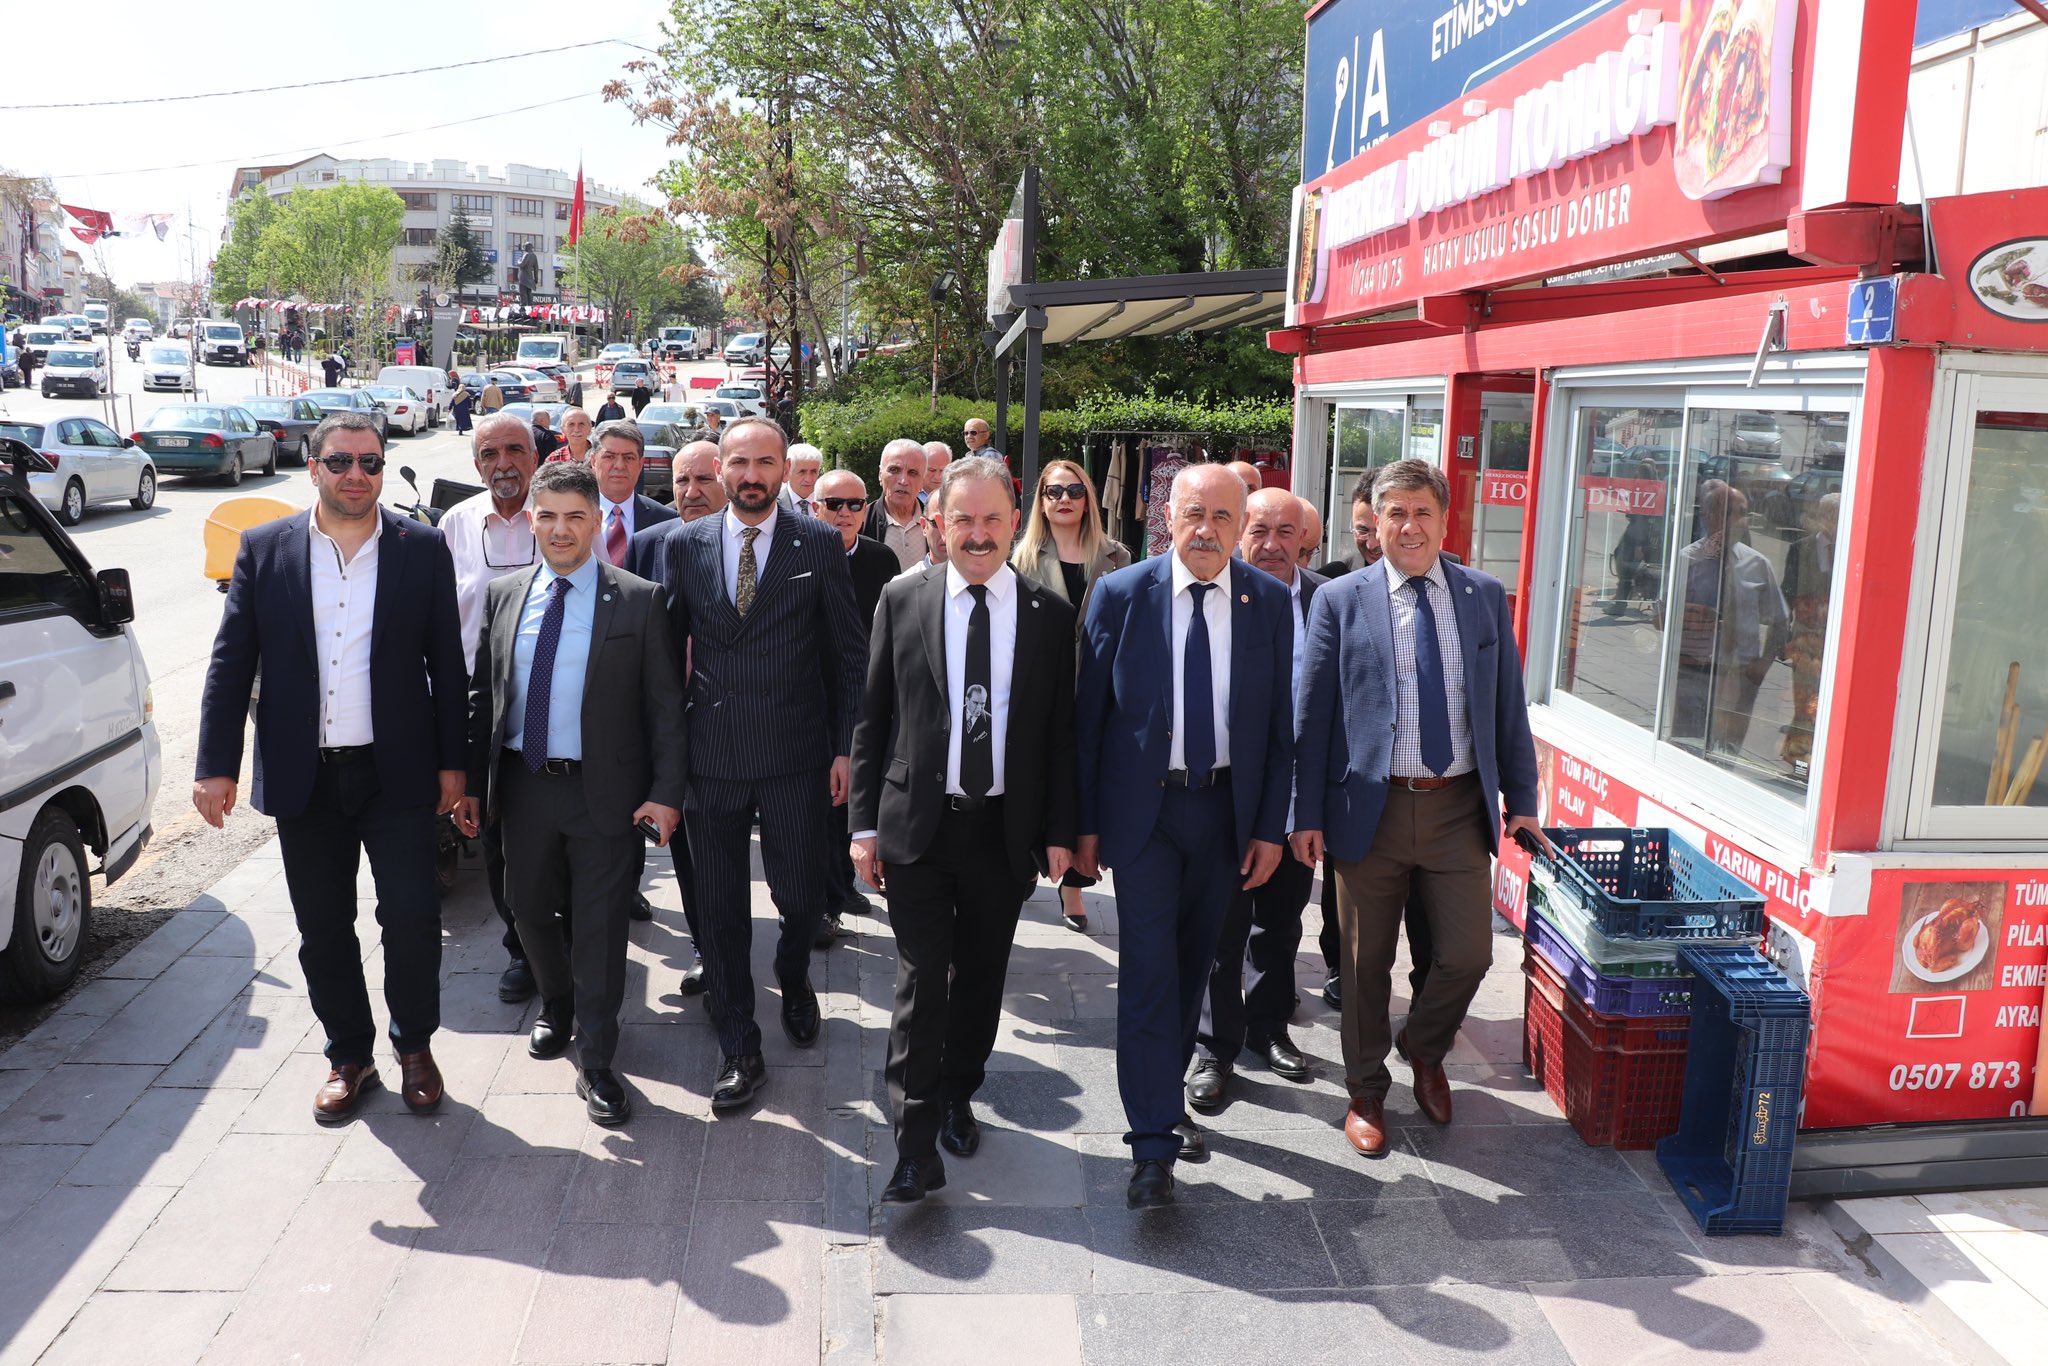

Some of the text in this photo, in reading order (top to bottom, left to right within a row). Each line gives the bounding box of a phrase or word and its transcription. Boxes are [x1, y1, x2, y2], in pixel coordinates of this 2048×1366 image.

[1431, 0, 1528, 62] ETİMES
[1359, 28, 1389, 140] A
[1404, 99, 1512, 220] DÜRÜM
[1510, 9, 1680, 179] KONAĞI
[1422, 183, 1632, 276] HATAY USULÜ SOSLU DÖNER
[1389, 257, 1403, 288] 75
[1863, 285, 1875, 319] 2
[1559, 785, 1586, 818] PİLAV
[1561, 754, 1609, 802] TÜM PİLİÇ
[1497, 864, 1523, 913] 0507
[1712, 839, 1812, 919] YARIM PİLİÇ
[2007, 919, 2048, 947] PİLA
[1889, 1060, 2021, 1091] 0507 873
